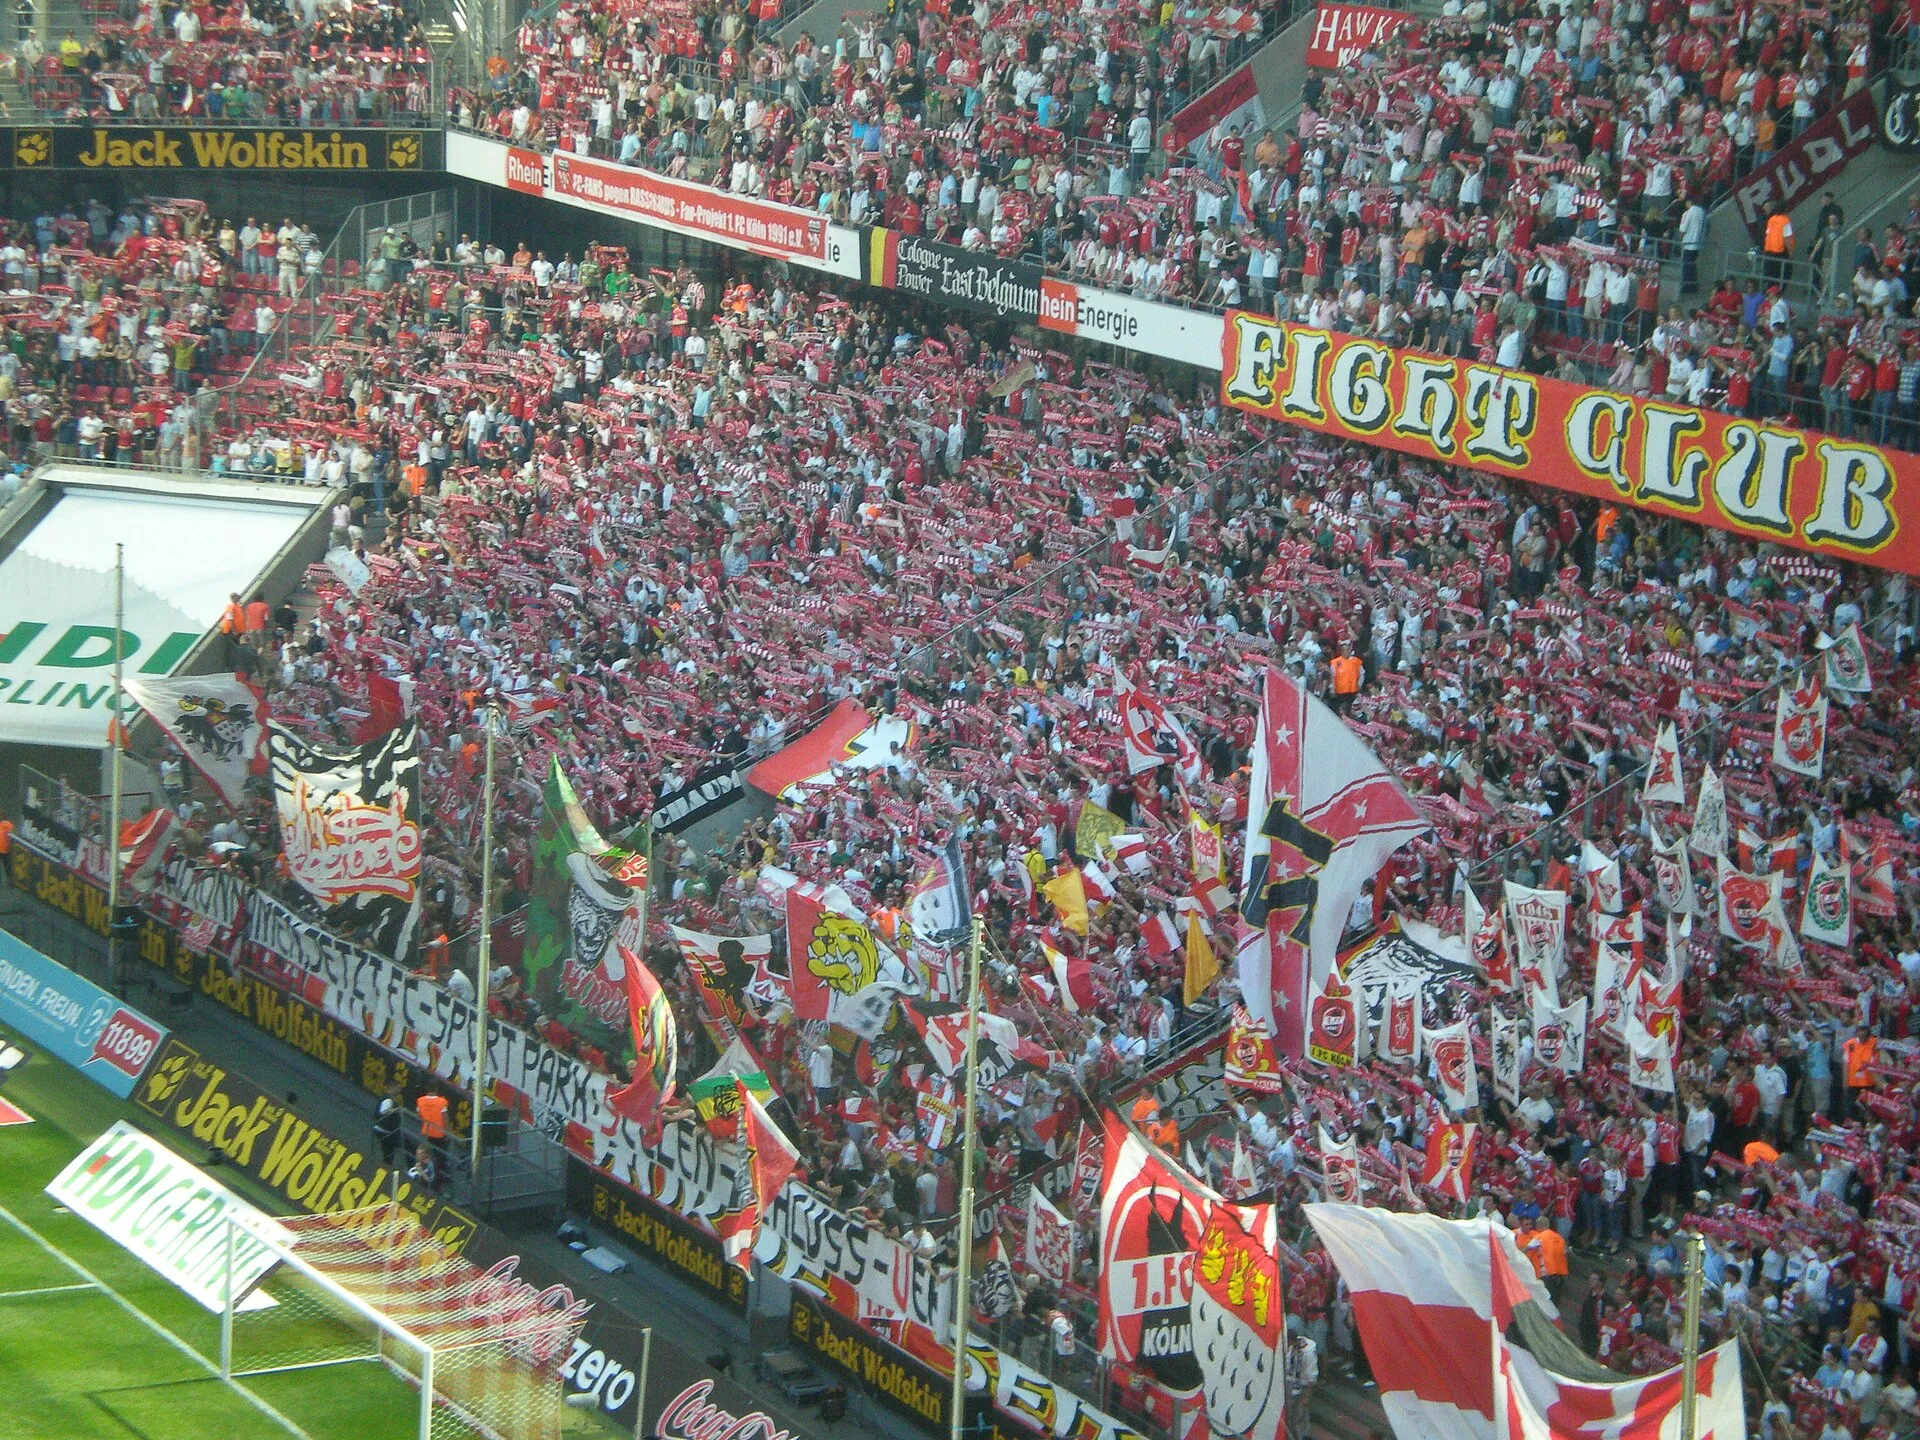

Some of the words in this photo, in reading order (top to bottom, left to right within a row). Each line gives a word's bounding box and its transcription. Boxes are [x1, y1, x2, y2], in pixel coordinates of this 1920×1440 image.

[78, 130, 183, 168] Jack
[190, 131, 369, 169] Wolfskin
[767, 222, 788, 244] 1991
[897, 237, 942, 271] Cologne
[897, 263, 934, 295] Power
[941, 255, 975, 297] East
[975, 264, 1040, 316] Belgium
[1230, 317, 1537, 467] FIGHT
[1567, 391, 1899, 553] CLUB
[101, 1020, 153, 1067] 11899
[201, 954, 252, 1020] Jack
[256, 978, 349, 1074] Wolfskin
[176, 1066, 270, 1166] Jack
[61, 1130, 160, 1222] HDI
[612, 1199, 653, 1236] Jack
[652, 1226, 724, 1291] Wolfskin
[1143, 1317, 1192, 1357] KÖLN
[556, 1337, 636, 1412] zero
[815, 1321, 863, 1374] Jack
[861, 1349, 944, 1424] Wolfskin
